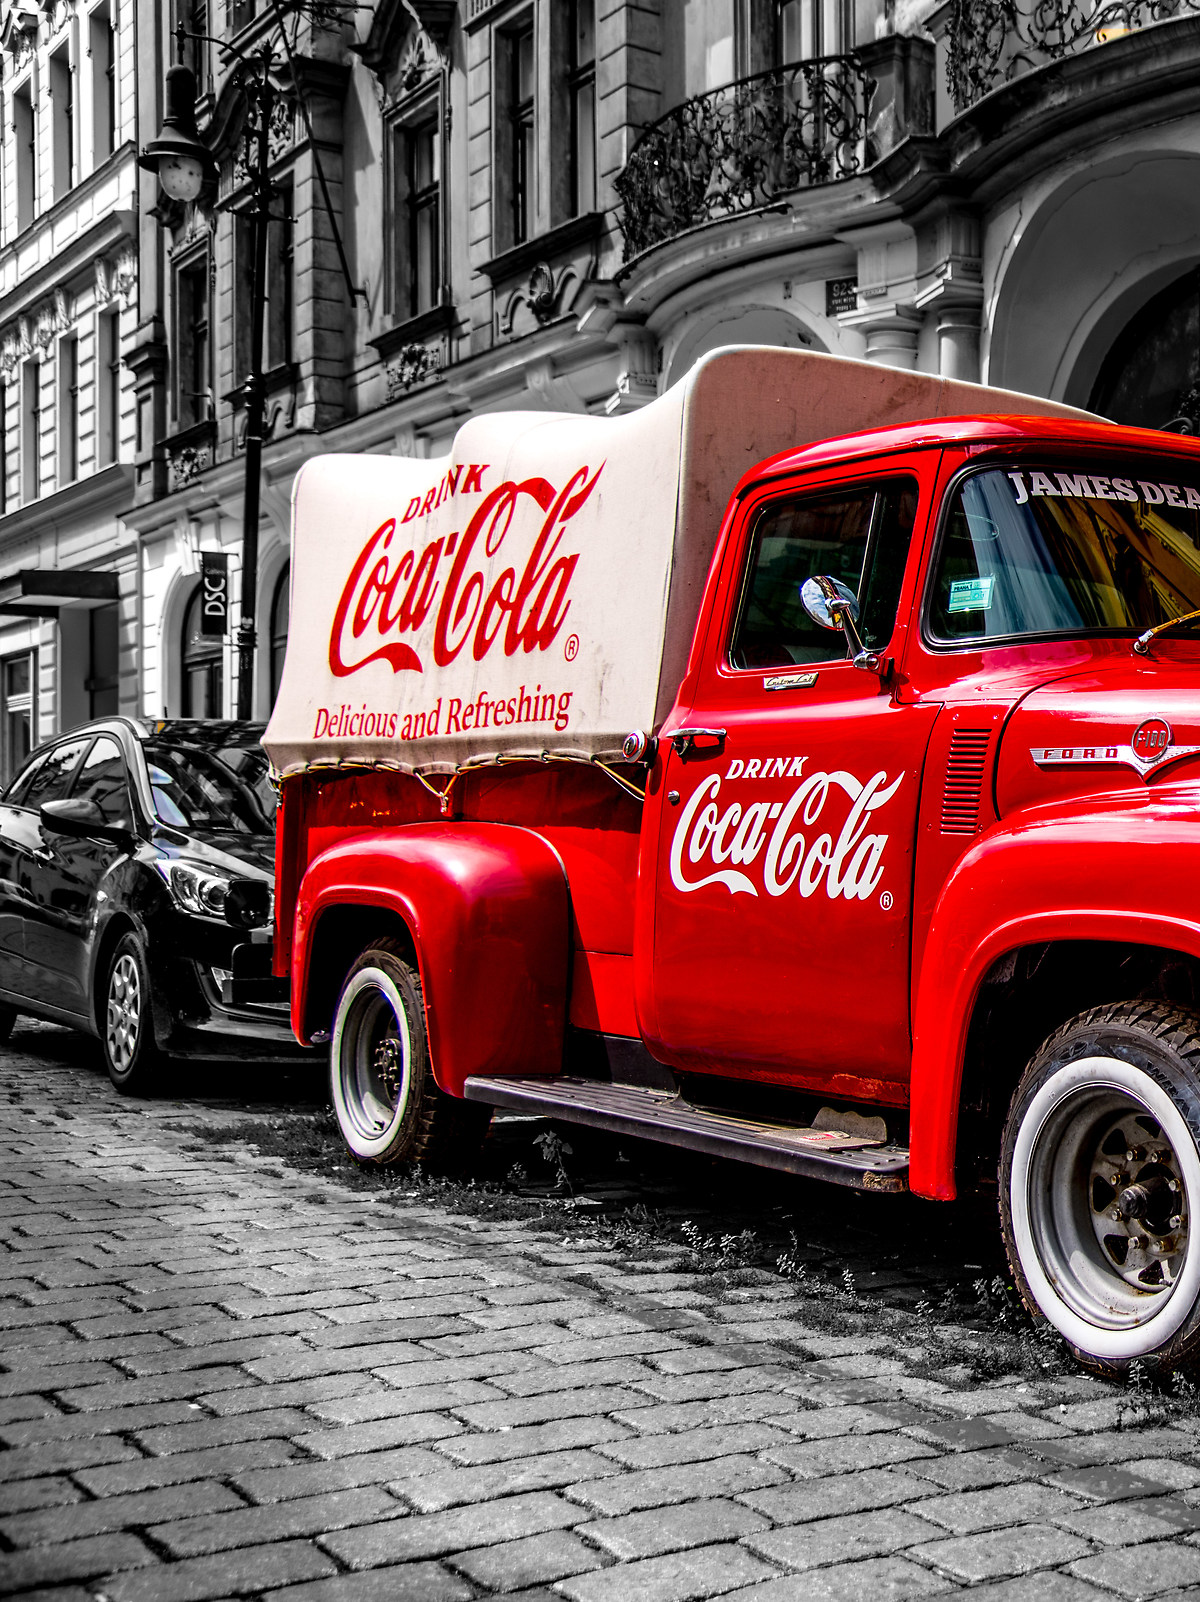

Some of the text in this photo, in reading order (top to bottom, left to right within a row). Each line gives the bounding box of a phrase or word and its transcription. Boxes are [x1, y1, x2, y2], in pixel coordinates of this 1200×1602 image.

[832, 281, 856, 297] 923
[400, 464, 490, 524] DRINK
[204, 577, 226, 616] DSC
[313, 684, 573, 741] Delicious and Refreshing
[1135, 730, 1167, 748] F-100
[1043, 749, 1118, 759] FORD
[725, 756, 809, 780] DRINK
